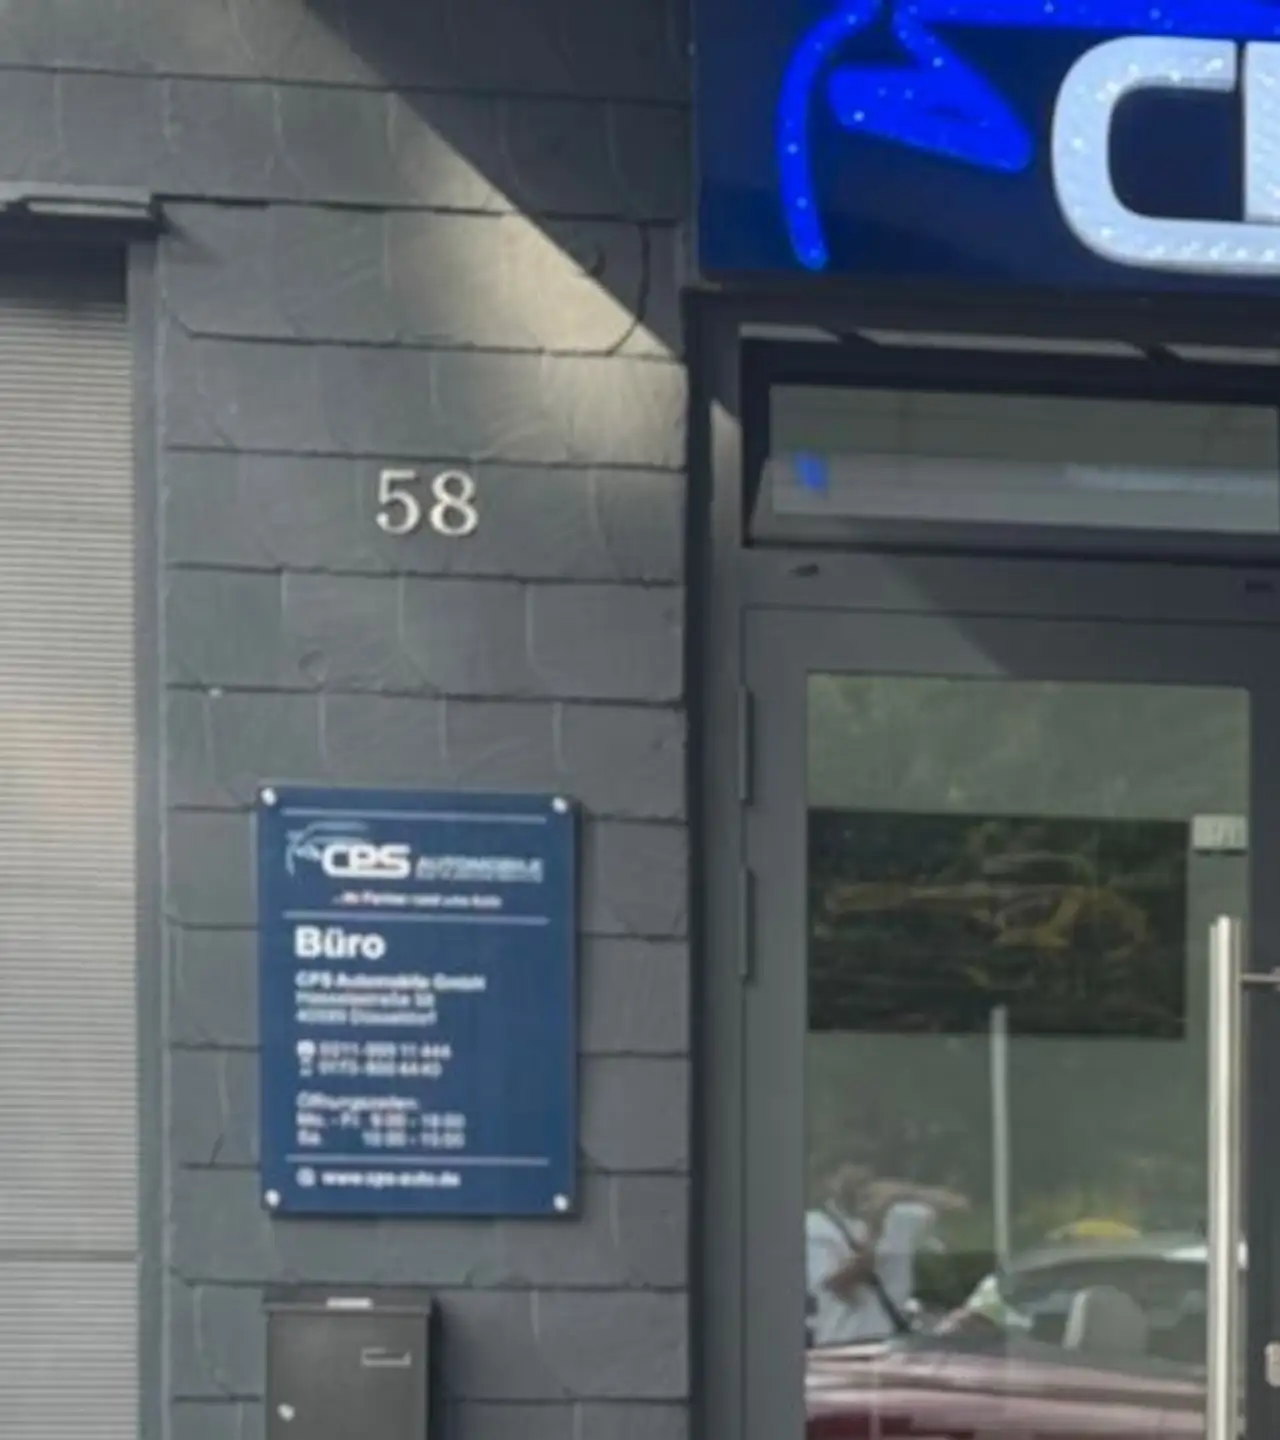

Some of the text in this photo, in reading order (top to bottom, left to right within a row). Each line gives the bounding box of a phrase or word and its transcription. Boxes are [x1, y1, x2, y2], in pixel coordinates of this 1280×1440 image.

[375, 467, 479, 537] 58
[321, 842, 411, 880] CPS
[294, 924, 388, 960] Büro
